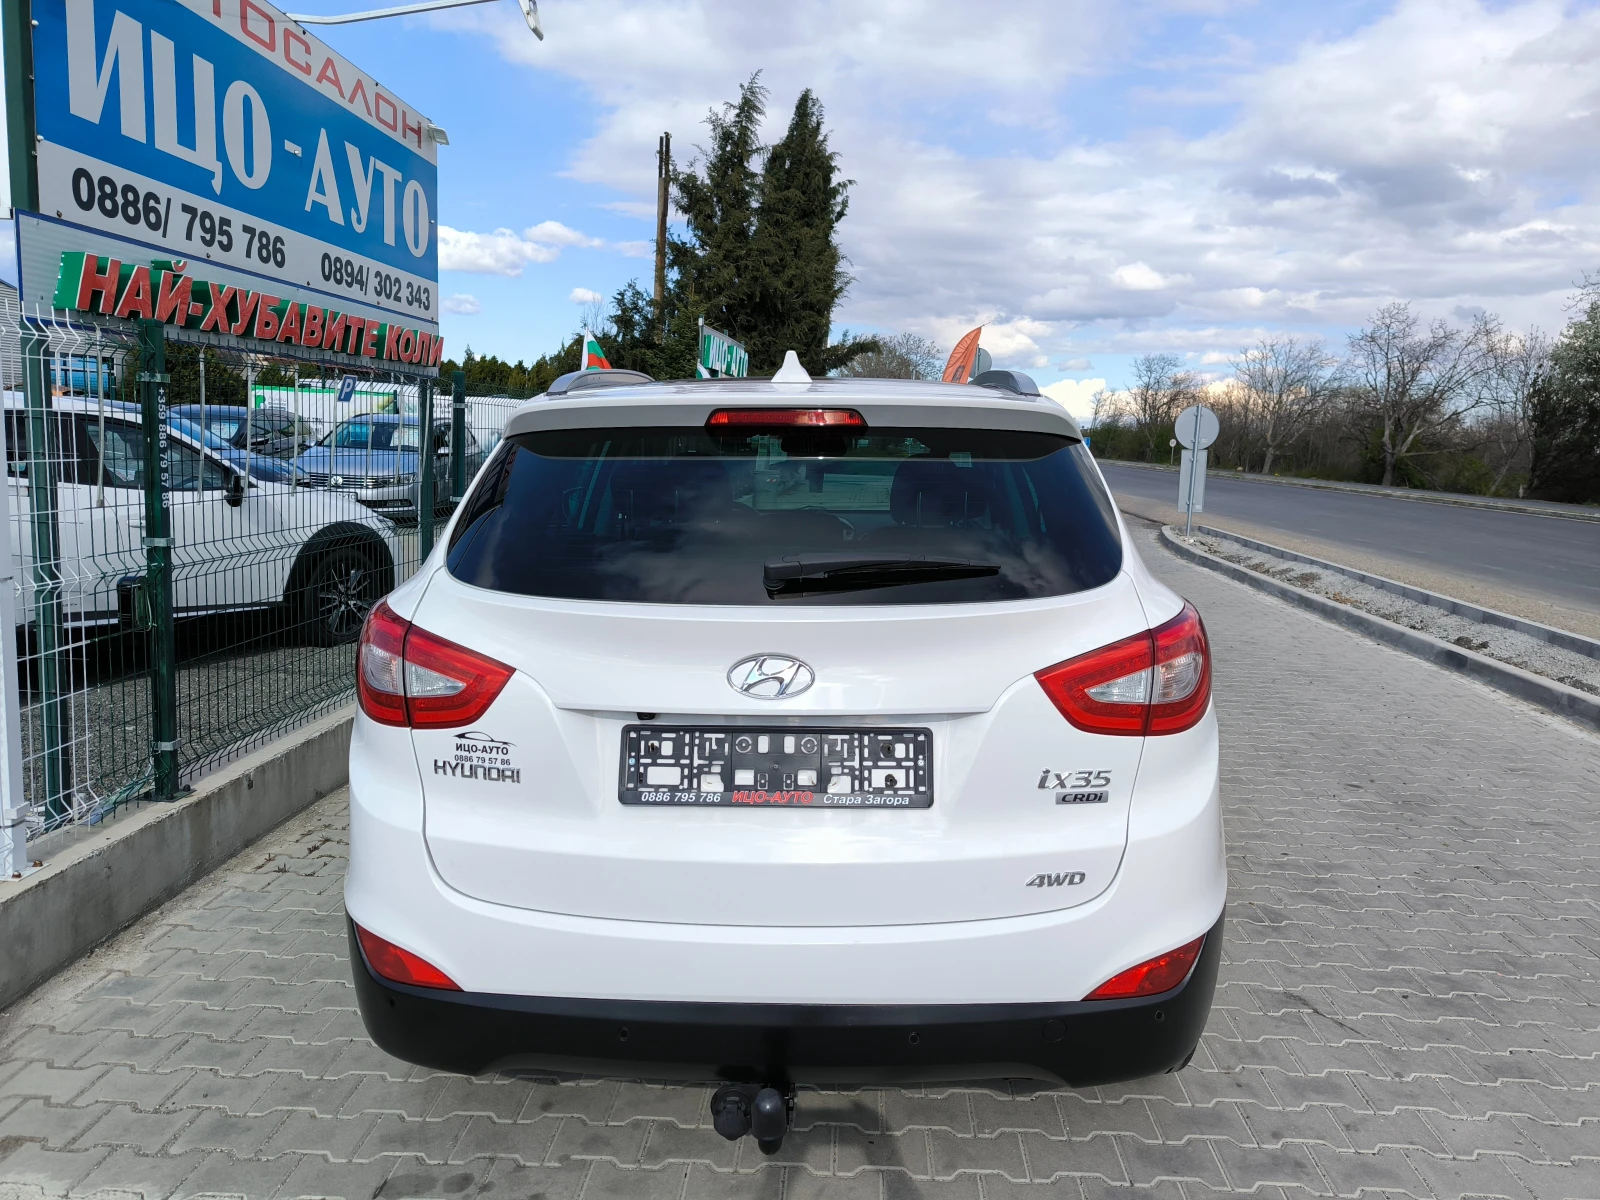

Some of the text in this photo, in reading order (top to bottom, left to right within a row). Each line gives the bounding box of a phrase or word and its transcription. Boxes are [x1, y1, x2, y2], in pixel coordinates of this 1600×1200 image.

[212, 0, 422, 149] ОСАЛОН
[71, 167, 286, 269] 0886/ 795 786
[320, 252, 431, 312] 0894/ 302 343
[75, 252, 445, 369] НАЙ-ХУБАВИТЕ КОЛИ
[341, 378, 354, 399] P
[158, 387, 170, 508] +359 886 79 57 86
[454, 754, 511, 766] 0886 79 57 86
[455, 743, 509, 755] ИЦО-АУТО
[433, 759, 521, 784] HYUNDAI
[1037, 767, 1112, 789] ix35
[641, 790, 910, 806] 0886 795 786 ИЦО-АУТО Стара Загора
[1061, 792, 1104, 803] CRDi
[1026, 870, 1086, 888] 4WD
